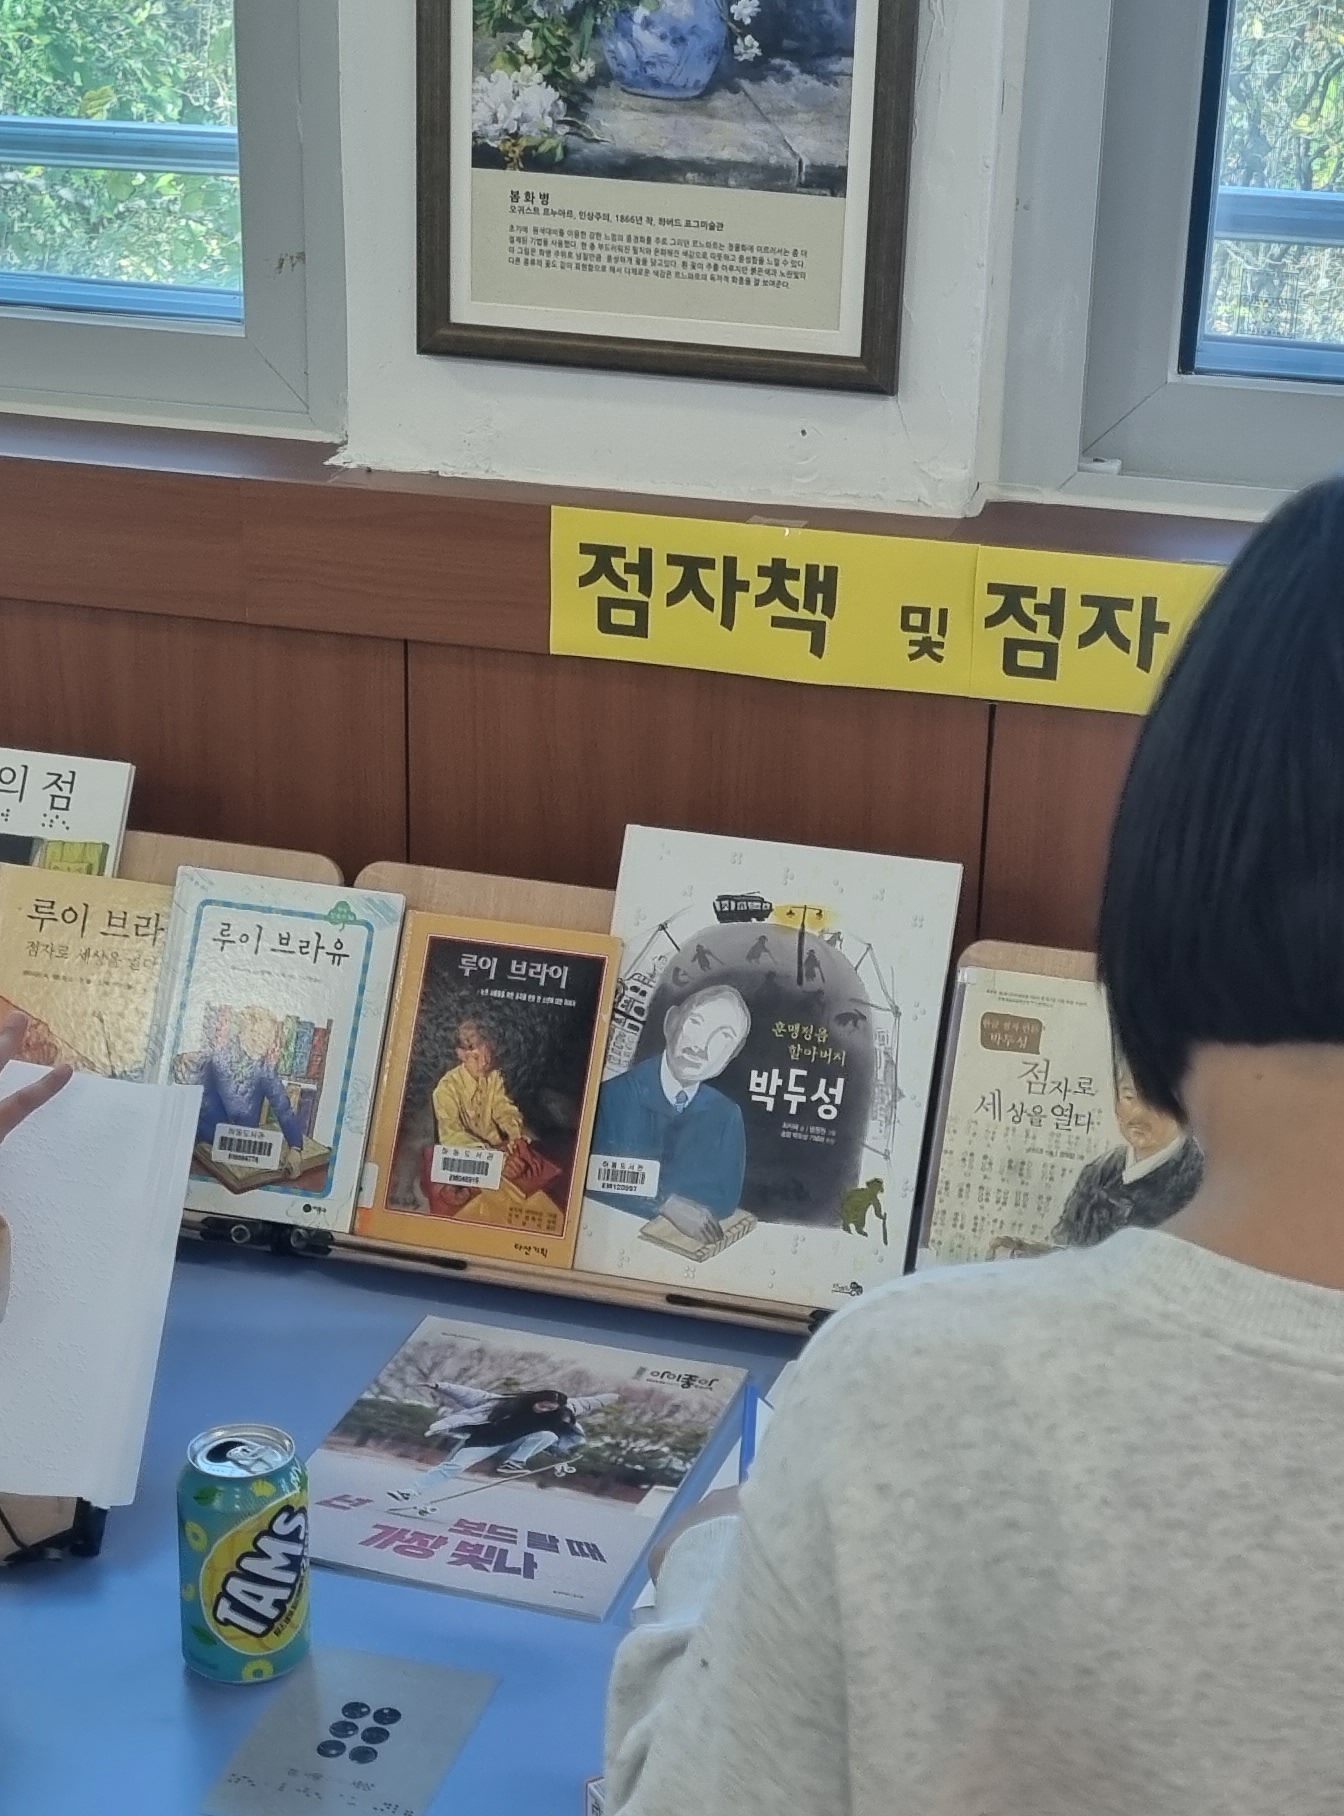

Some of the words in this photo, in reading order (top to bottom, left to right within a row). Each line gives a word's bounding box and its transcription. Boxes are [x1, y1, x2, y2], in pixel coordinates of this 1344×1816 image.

[509, 205, 540, 216] 오귀스트
[658, 217, 682, 227] 하버드
[576, 539, 839, 660] 점자책
[898, 603, 950, 665] 및
[983, 580, 1171, 684] 점자
[41, 771, 77, 812] 점
[26, 898, 89, 939] 루이
[99, 910, 165, 947] 브라
[212, 922, 263, 955] 루이
[270, 931, 350, 967] 브라유
[26, 940, 69, 960] 점자로
[77, 947, 123, 968] 세상을
[458, 953, 498, 980] 루이
[507, 959, 569, 990] 브라이
[772, 1020, 829, 1044] 훈맹정음
[749, 1068, 845, 1120] 박두성
[1018, 1058, 1096, 1101] 점자로
[974, 1088, 1047, 1129] 세상을
[1051, 1102, 1093, 1135] 열다
[359, 1523, 449, 1560] 가장
[447, 1540, 538, 1580] 빛나
[448, 1518, 519, 1545] 보드
[566, 1538, 607, 1563] 때
[212, 1504, 307, 1638] TAMS
